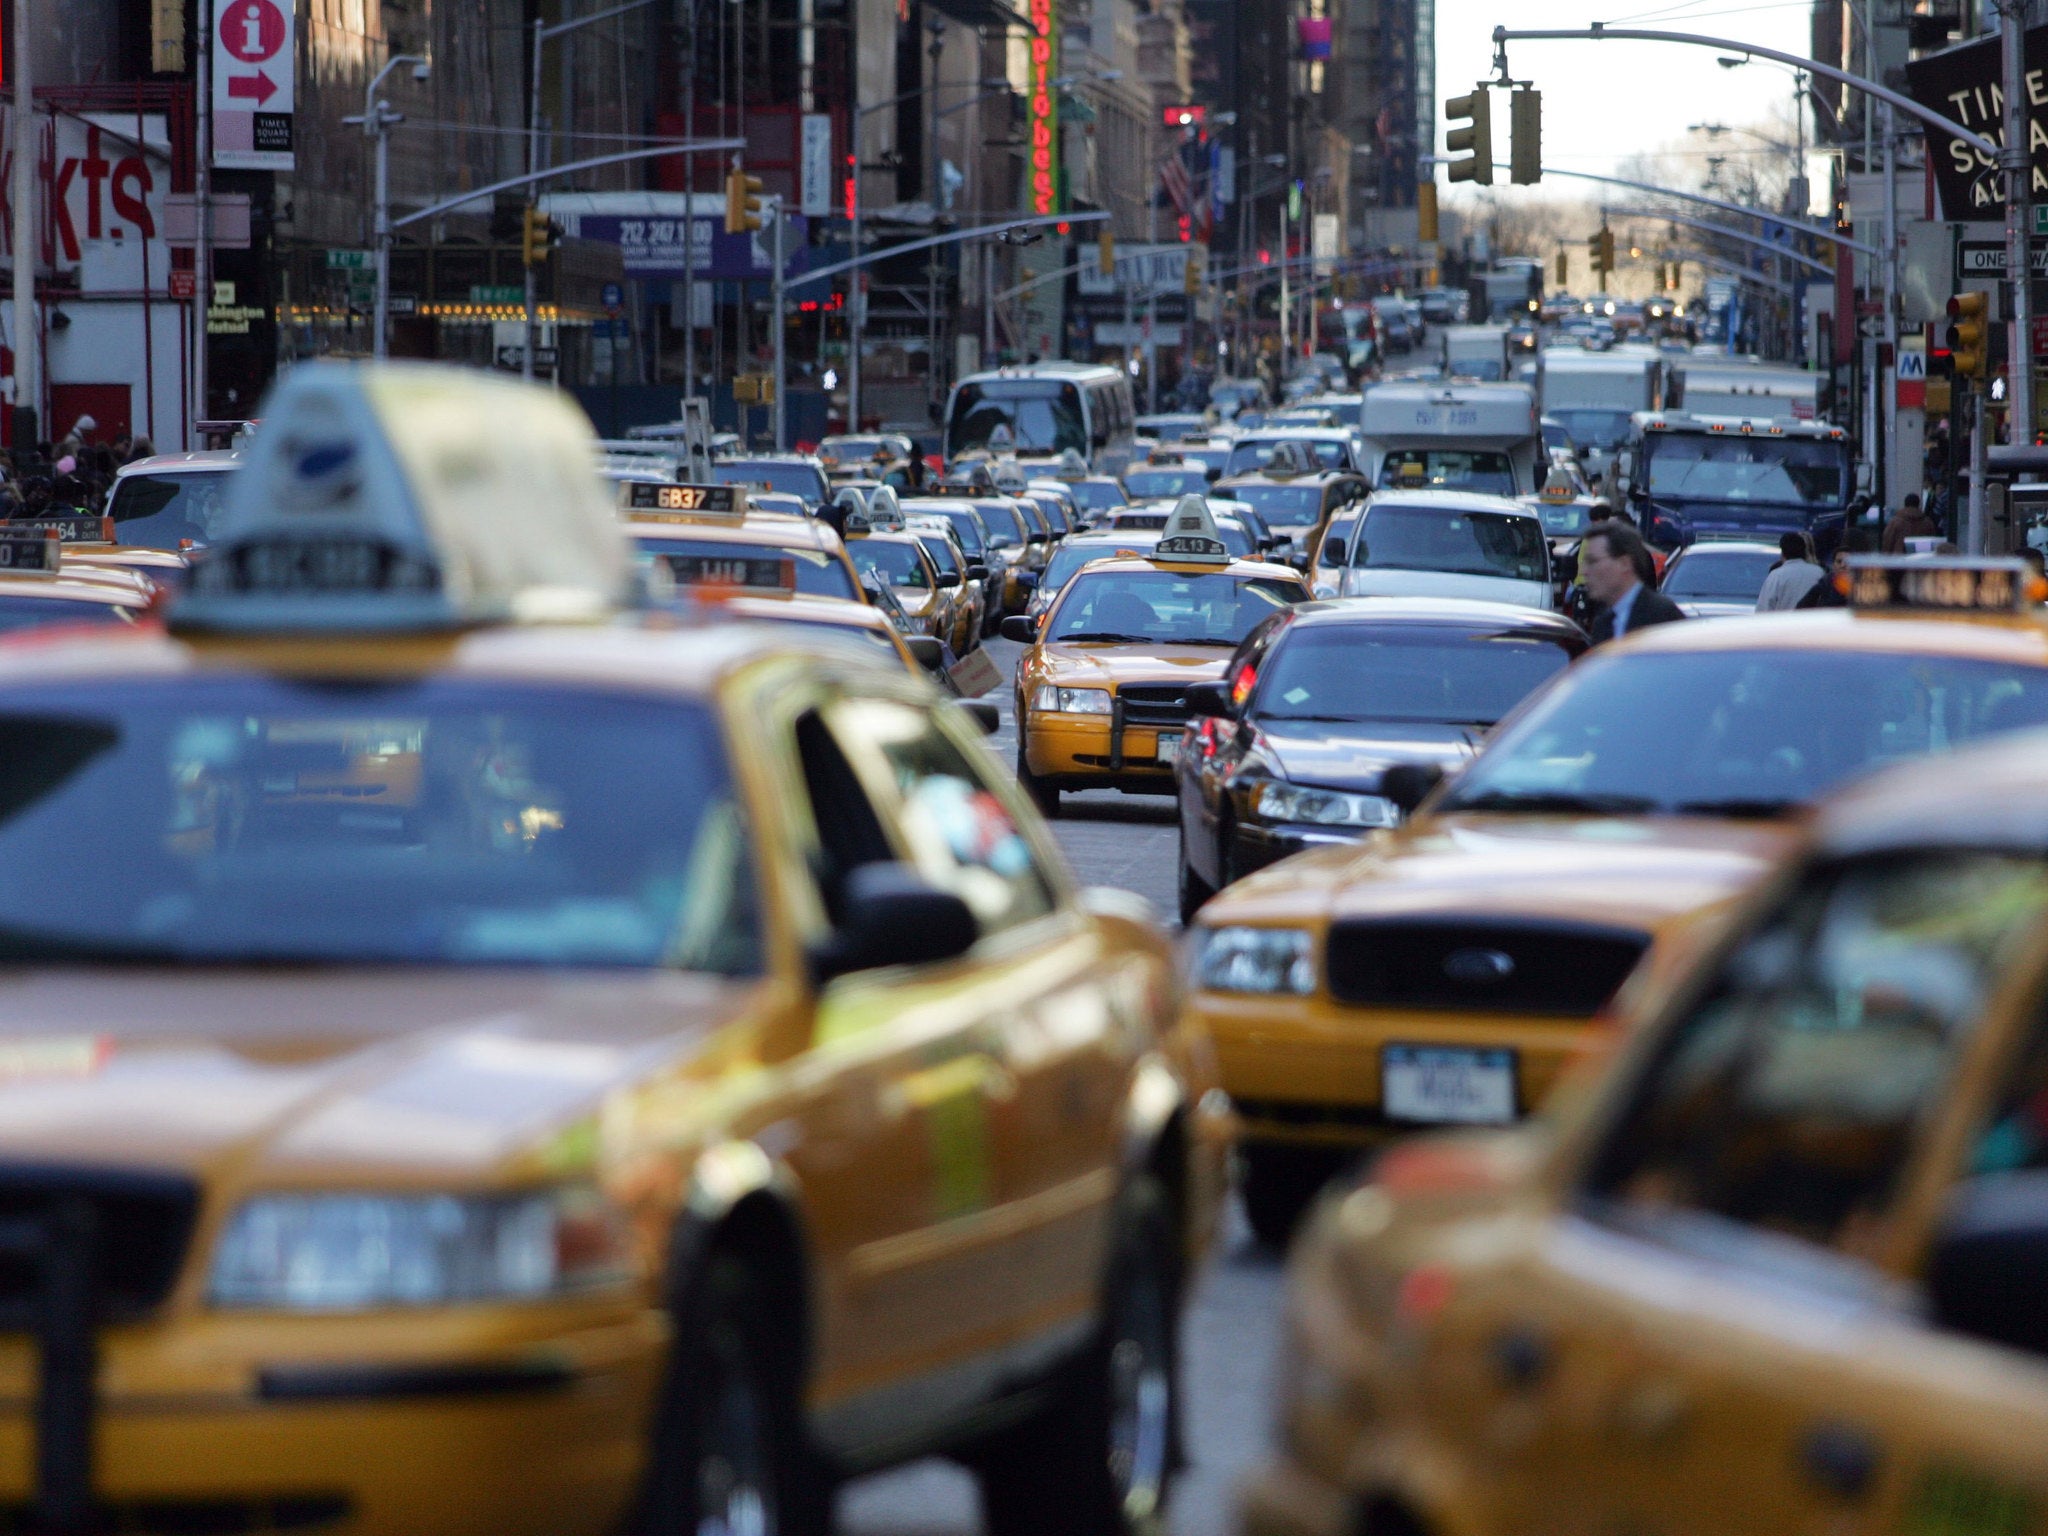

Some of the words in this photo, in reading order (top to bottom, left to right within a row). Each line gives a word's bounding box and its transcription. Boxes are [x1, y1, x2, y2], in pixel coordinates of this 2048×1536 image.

[260, 119, 287, 128] TIMES
[257, 128, 290, 138] SQUARE
[1974, 253, 2007, 268] ONE
[658, 487, 707, 509] 6B37
[1173, 538, 1205, 552] 2L13
